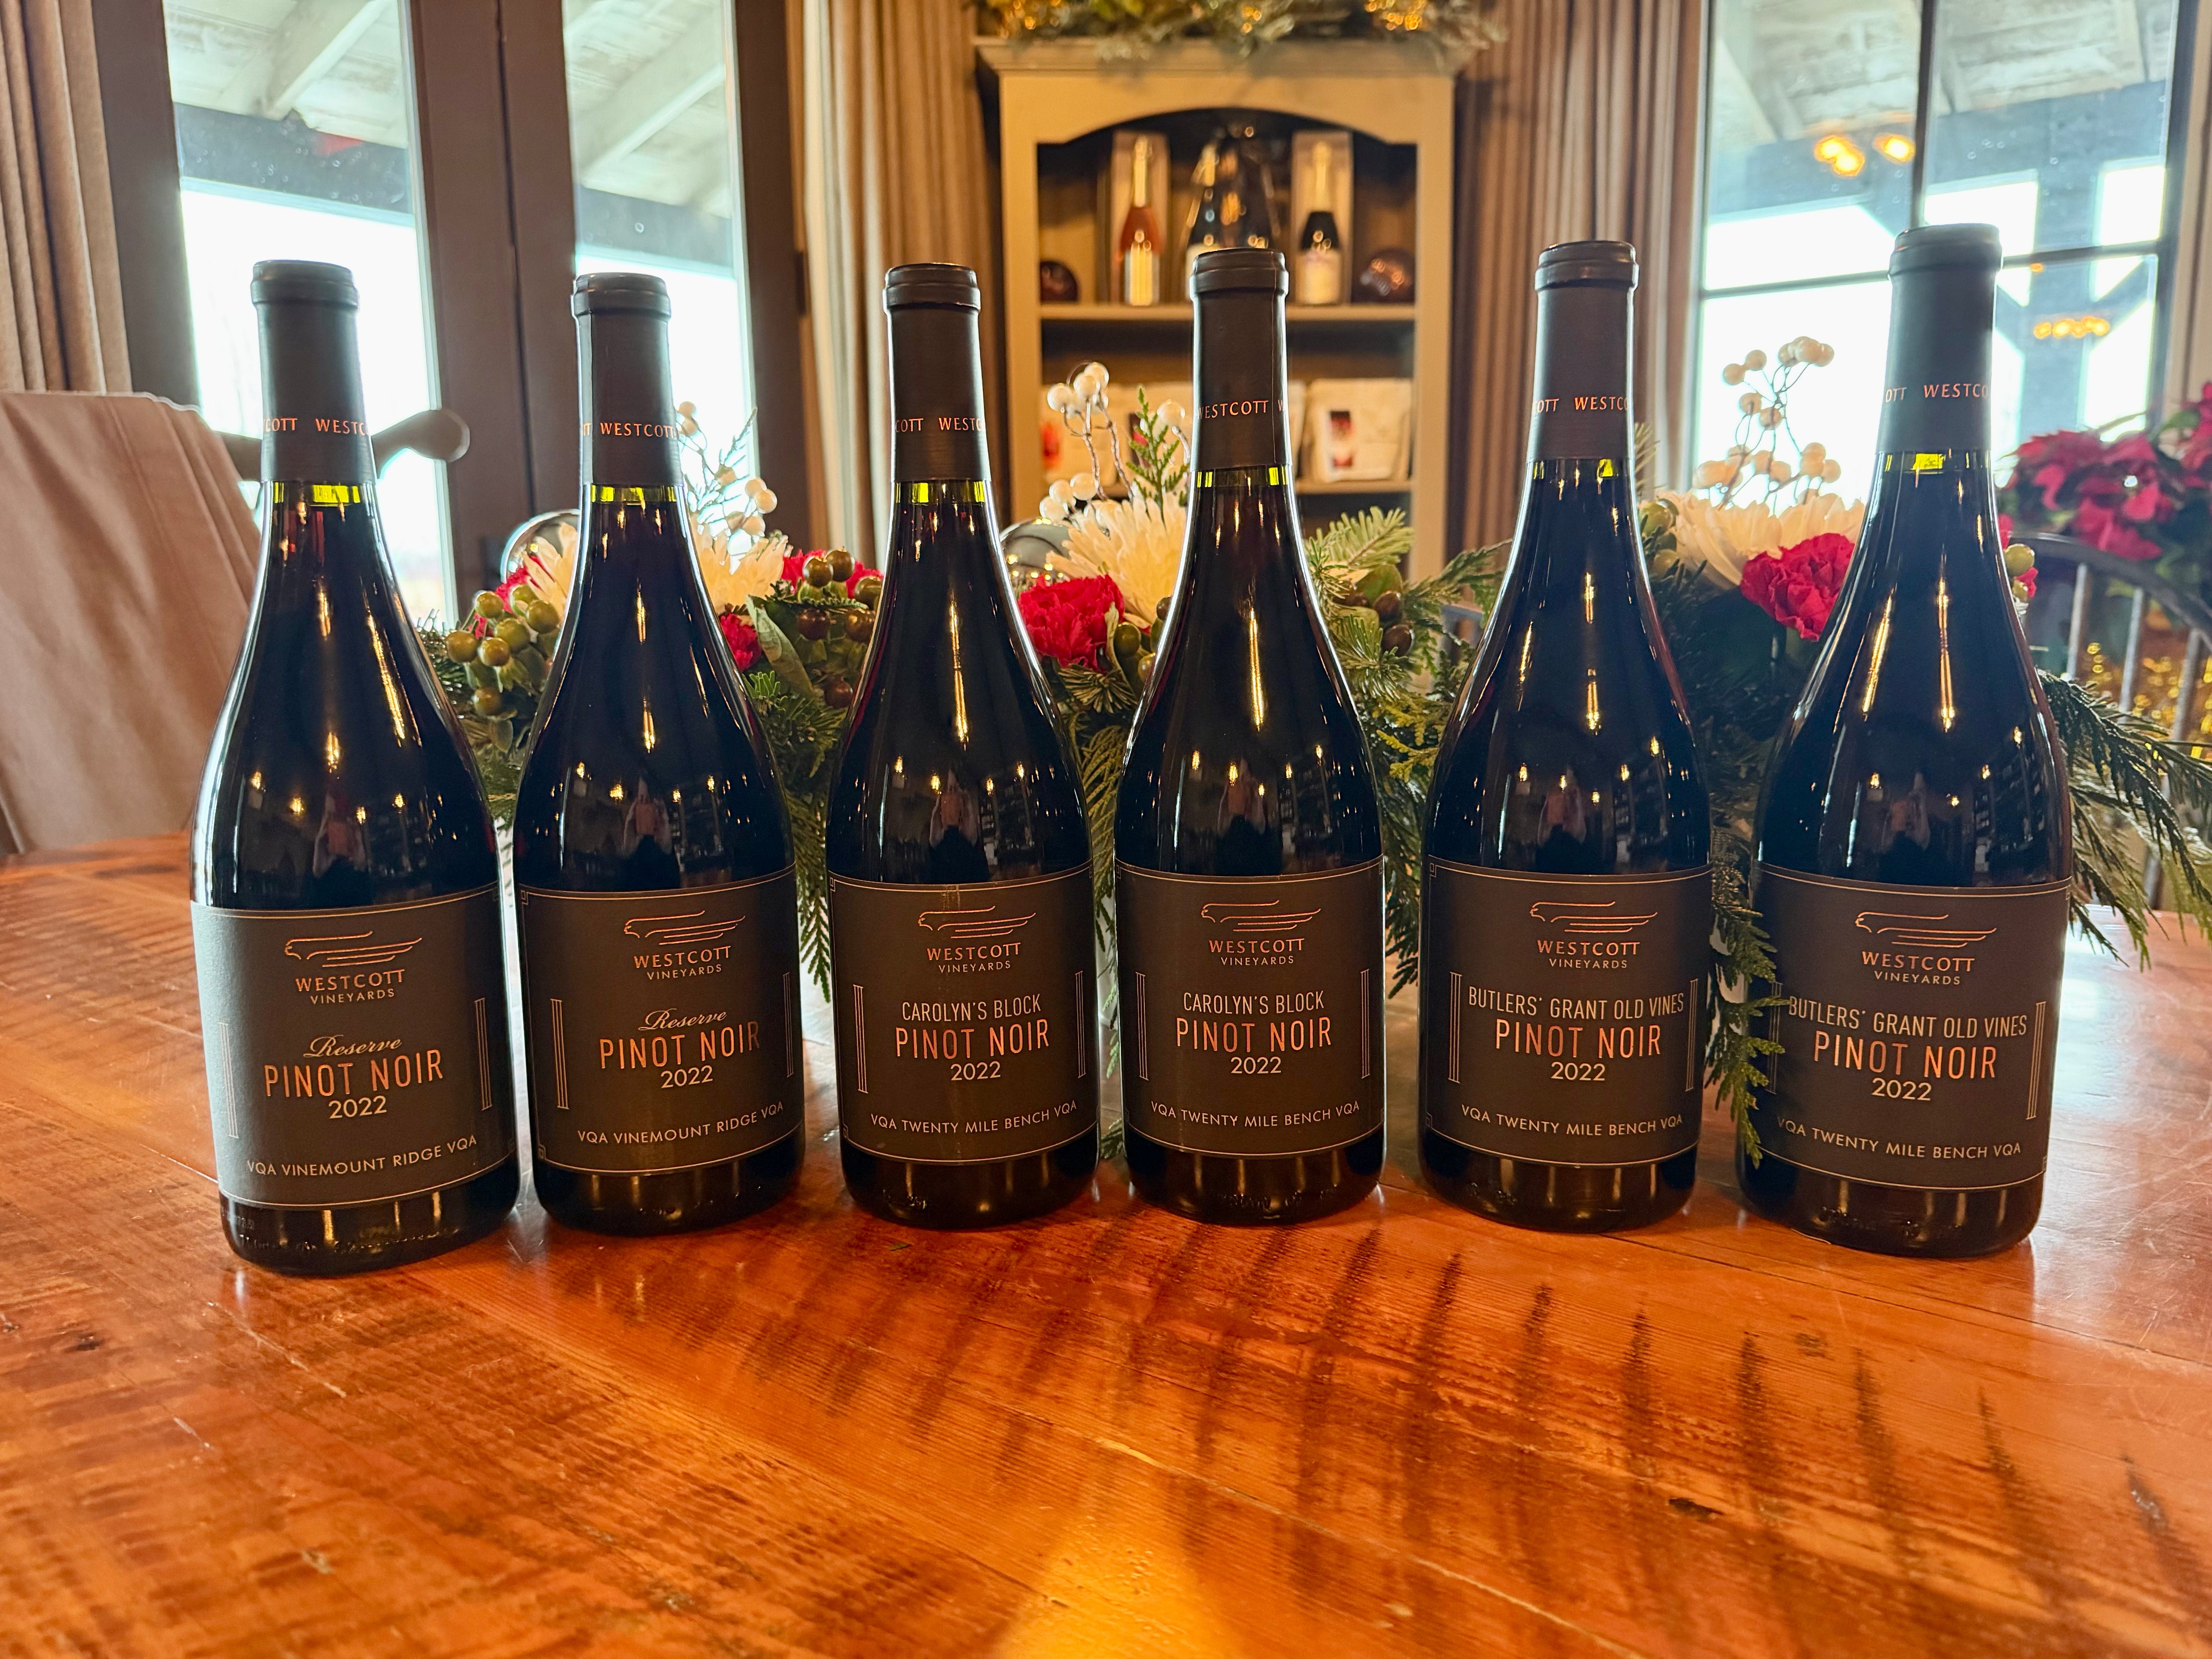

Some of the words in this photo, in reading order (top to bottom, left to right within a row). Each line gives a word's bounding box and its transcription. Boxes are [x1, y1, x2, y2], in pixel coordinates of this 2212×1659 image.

[599, 422, 674, 438] WESTCOTT
[634, 945, 731, 969] WESTCOTT
[926, 942, 1021, 960] WESTCOTT
[1209, 938, 1305, 954] WESTCOTT
[1537, 939, 1640, 956] WESTCOTT
[647, 963, 722, 981] VINEYARDS
[938, 960, 1011, 973] VINEYARDS
[1221, 955, 1294, 966] VINEYARDS
[1549, 958, 1628, 969] VINEYARDS
[1862, 951, 1975, 972] WESTCOTT
[295, 969, 405, 992] WESTCOTT
[1874, 970, 1961, 986] VINEYARDS
[311, 988, 395, 1005] VINEYARDS
[902, 1001, 987, 1022] CAROLYN'S
[994, 993, 1041, 1019] BLOCK
[1183, 992, 1269, 1015] CAROLYN'S
[1276, 990, 1324, 1013] BLOCK
[1468, 986, 1543, 1017] BUTLERS'
[1550, 998, 1607, 1020] GRANT
[1614, 999, 1643, 1019] OLD
[1649, 992, 1684, 1017] VINES
[638, 1008, 728, 1031] Reserve
[1873, 1012, 1938, 1037] GRANT
[1943, 1017, 1978, 1039] OLD
[1984, 1015, 2027, 1039] VINES
[303, 1034, 403, 1058] Reserve
[599, 1034, 685, 1069] PINOT
[700, 1021, 760, 1061] NOIR
[895, 1027, 974, 1060] PINOT
[989, 1018, 1049, 1057] NOIR
[1175, 1017, 1255, 1053] PINOT
[1270, 1016, 1331, 1052] NOIR
[1496, 1018, 1583, 1059] PINOT
[1598, 1024, 1661, 1059] NOIR
[1230, 1056, 1281, 1074] 2022
[1813, 1030, 1908, 1075] PINOT
[1924, 1045, 1997, 1080] NOIR
[264, 1062, 354, 1097] PINOT
[371, 1049, 444, 1091] NOIR
[660, 1065, 714, 1089] 2022
[950, 1061, 1001, 1081] 2022
[1551, 1061, 1606, 1081] 2022
[1871, 1077, 1932, 1102] 2022
[328, 1096, 388, 1120] 2022
[871, 1113, 897, 1130] VQA
[902, 1120, 959, 1133] TWENTY
[965, 1120, 999, 1133] MILE
[1004, 1109, 1049, 1130] BENCH
[1053, 1100, 1077, 1117] VQA
[1151, 1101, 1176, 1119] VQA
[1181, 1109, 1238, 1127] TWENTY
[1244, 1115, 1278, 1127] MILE
[1284, 1110, 1331, 1126] BENCH
[1335, 1100, 1360, 1118] VQA
[1461, 1104, 1491, 1123] VQA
[1496, 1113, 1559, 1134] TWENTY
[1566, 1123, 1602, 1136] MILE
[1609, 1120, 1656, 1136] BENCH
[1660, 1114, 1683, 1130] VQA
[577, 1130, 608, 1144] VQA
[613, 1123, 711, 1144] VINEMOUNT
[716, 1112, 757, 1133] RIDGE
[761, 1101, 784, 1119] VQA
[1777, 1116, 1806, 1137] VQA
[1811, 1127, 1879, 1152] TWENTY
[1885, 1141, 1925, 1158] MILE
[1932, 1146, 1987, 1159] BENCH
[1992, 1142, 2021, 1158] VQA
[247, 1160, 277, 1177] VQA
[281, 1157, 386, 1176] VINEMOUNT
[393, 1145, 442, 1167] RIDGE
[447, 1134, 477, 1154] VQA
